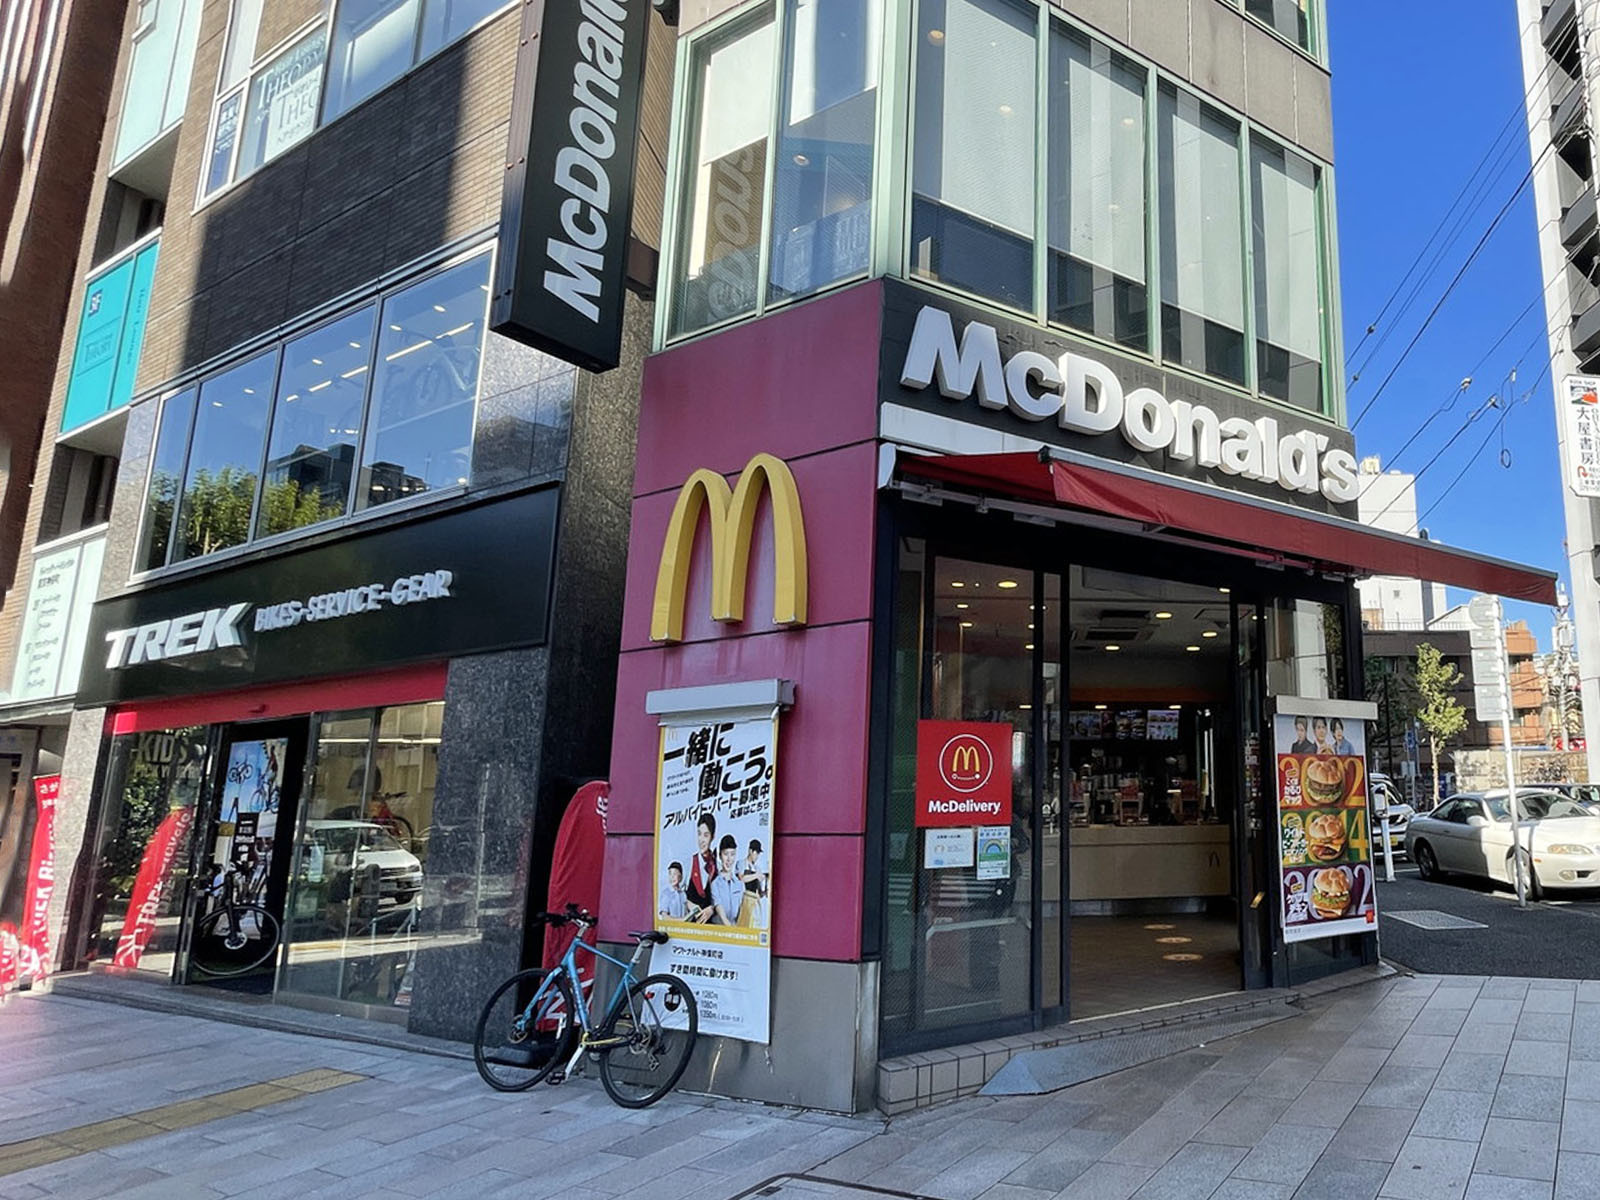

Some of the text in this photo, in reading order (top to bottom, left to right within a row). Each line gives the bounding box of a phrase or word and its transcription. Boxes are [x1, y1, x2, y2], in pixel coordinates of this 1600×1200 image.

[544, 0, 629, 324] McDonal
[900, 305, 1359, 505] McDonald's
[1577, 406, 1594, 466] 大屋書房
[105, 602, 251, 669] TREK
[664, 722, 735, 768] 一緒に
[698, 745, 773, 802] 働こう。
[928, 799, 1001, 815] McDelivery
